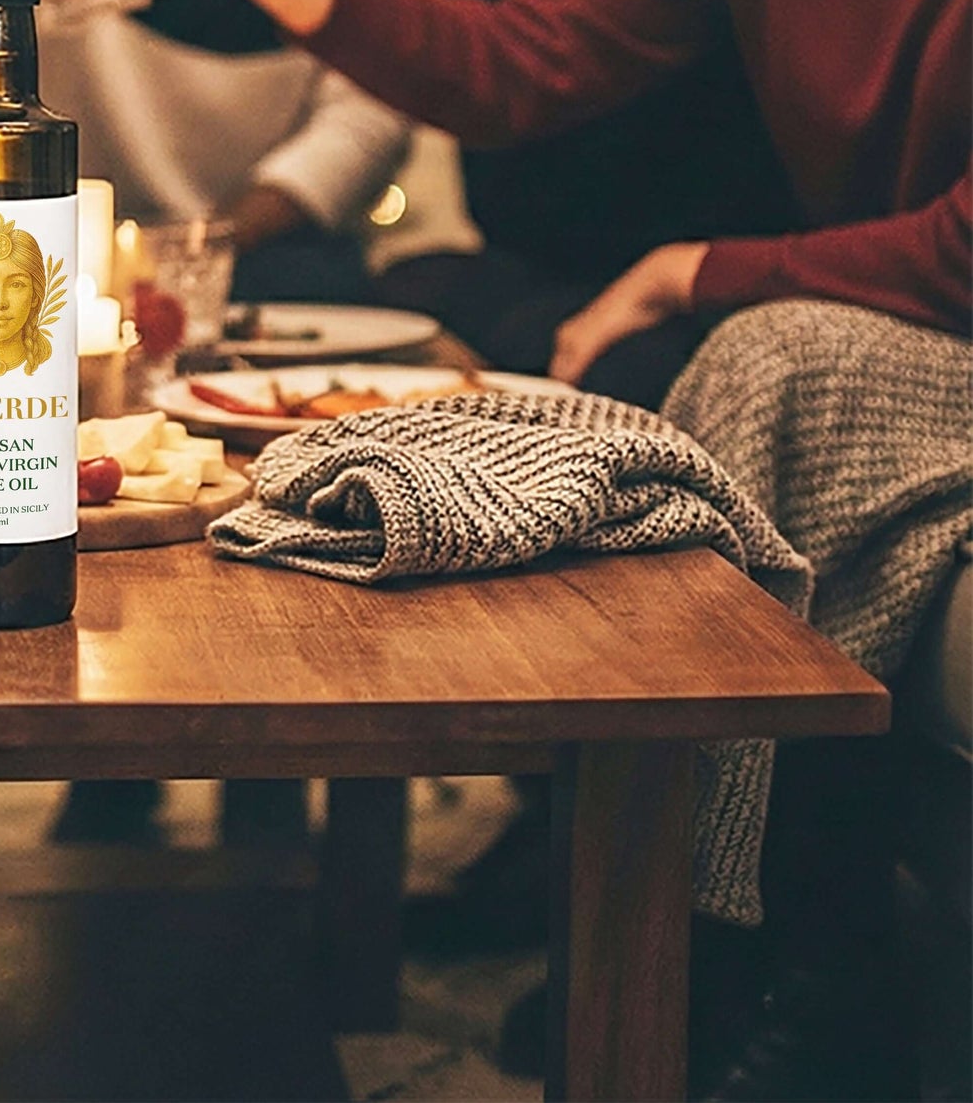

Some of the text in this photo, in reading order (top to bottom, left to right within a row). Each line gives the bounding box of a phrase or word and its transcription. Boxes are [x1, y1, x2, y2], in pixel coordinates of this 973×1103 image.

[8, 477, 39, 491] OIL
[10, 505, 20, 515] IN
[21, 503, 50, 514] SICILY
